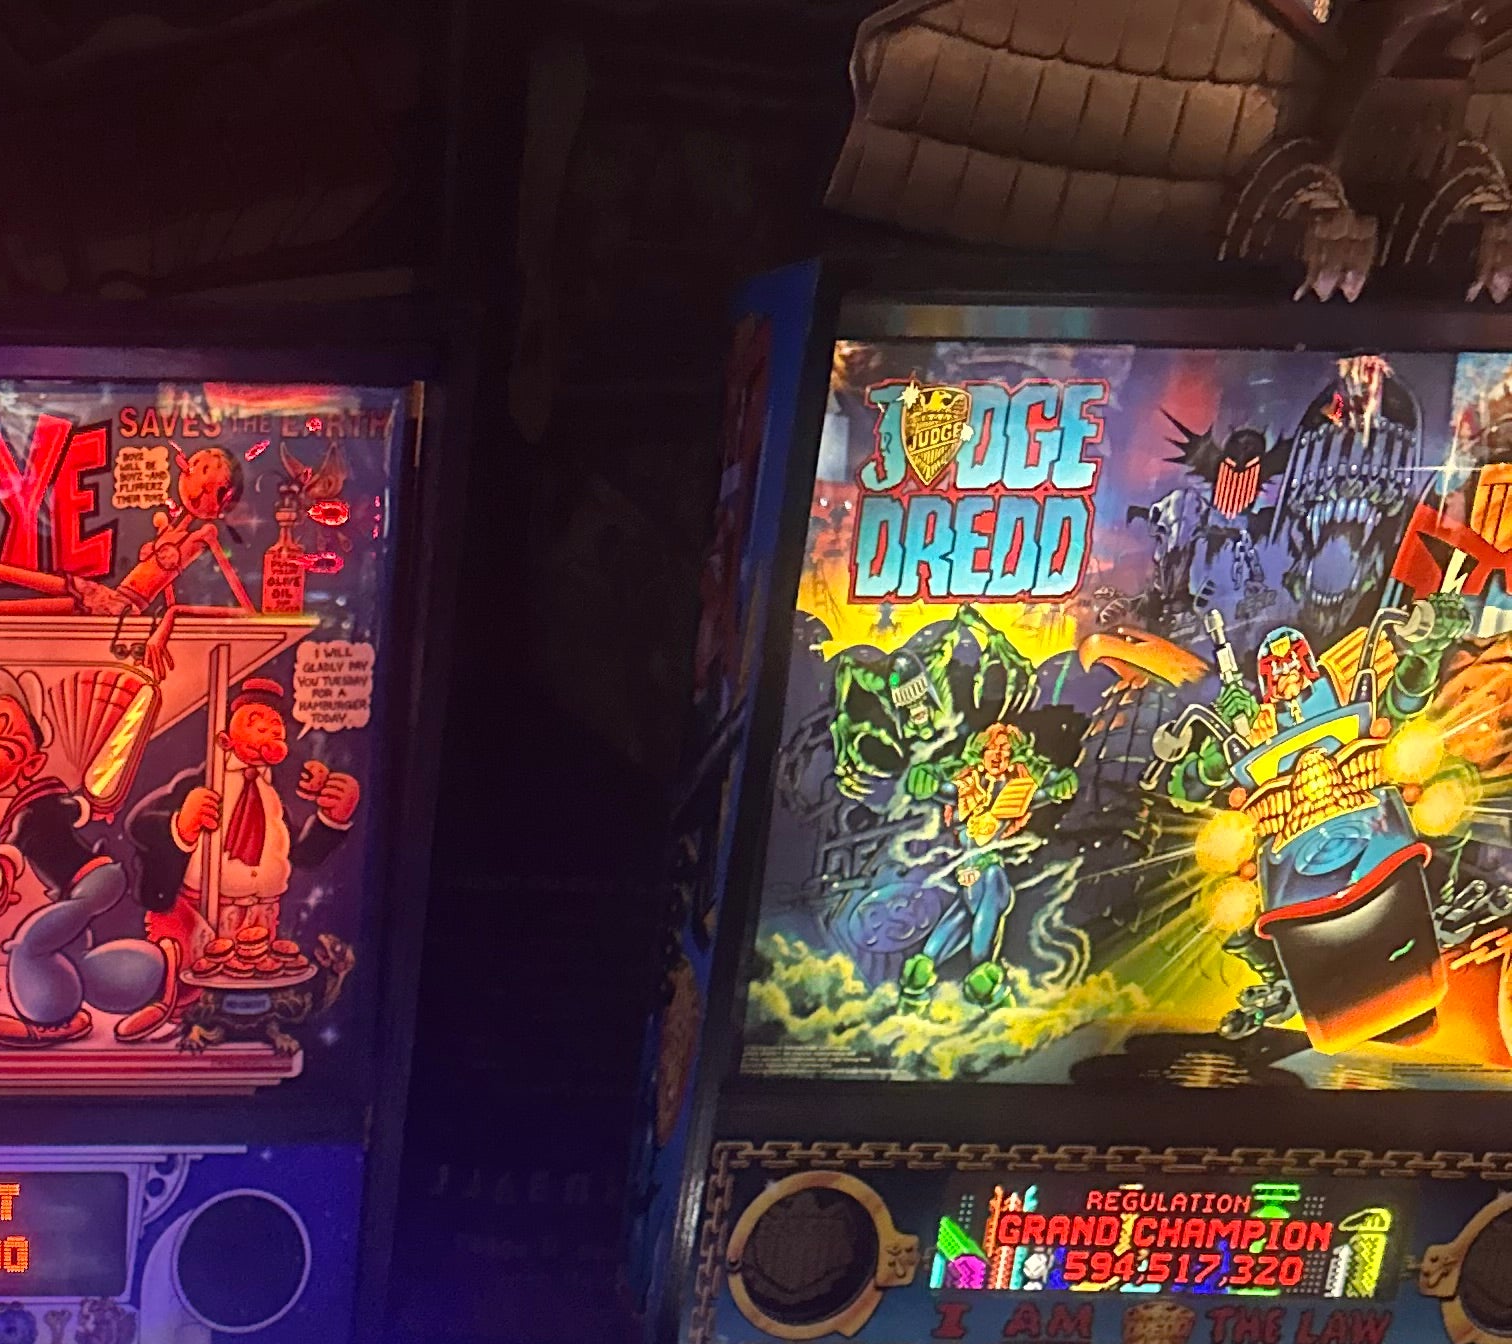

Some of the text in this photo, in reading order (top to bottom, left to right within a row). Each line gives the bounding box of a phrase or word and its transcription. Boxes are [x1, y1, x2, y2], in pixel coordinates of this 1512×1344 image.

[119, 407, 223, 439] SAVES
[857, 379, 1109, 491] JDGE
[908, 423, 963, 452] JUDGE
[852, 493, 1092, 600] DREDD
[302, 662, 345, 673] GLADLY
[323, 648, 352, 658] WILL
[297, 677, 320, 687] YOU
[1087, 1190, 1251, 1213] REGULATION
[996, 1214, 1332, 1251] GRAND CHAMPION
[1063, 1251, 1306, 1288] 594,517,320
[931, 1301, 970, 1338] I
[1003, 1302, 1094, 1340] AM
